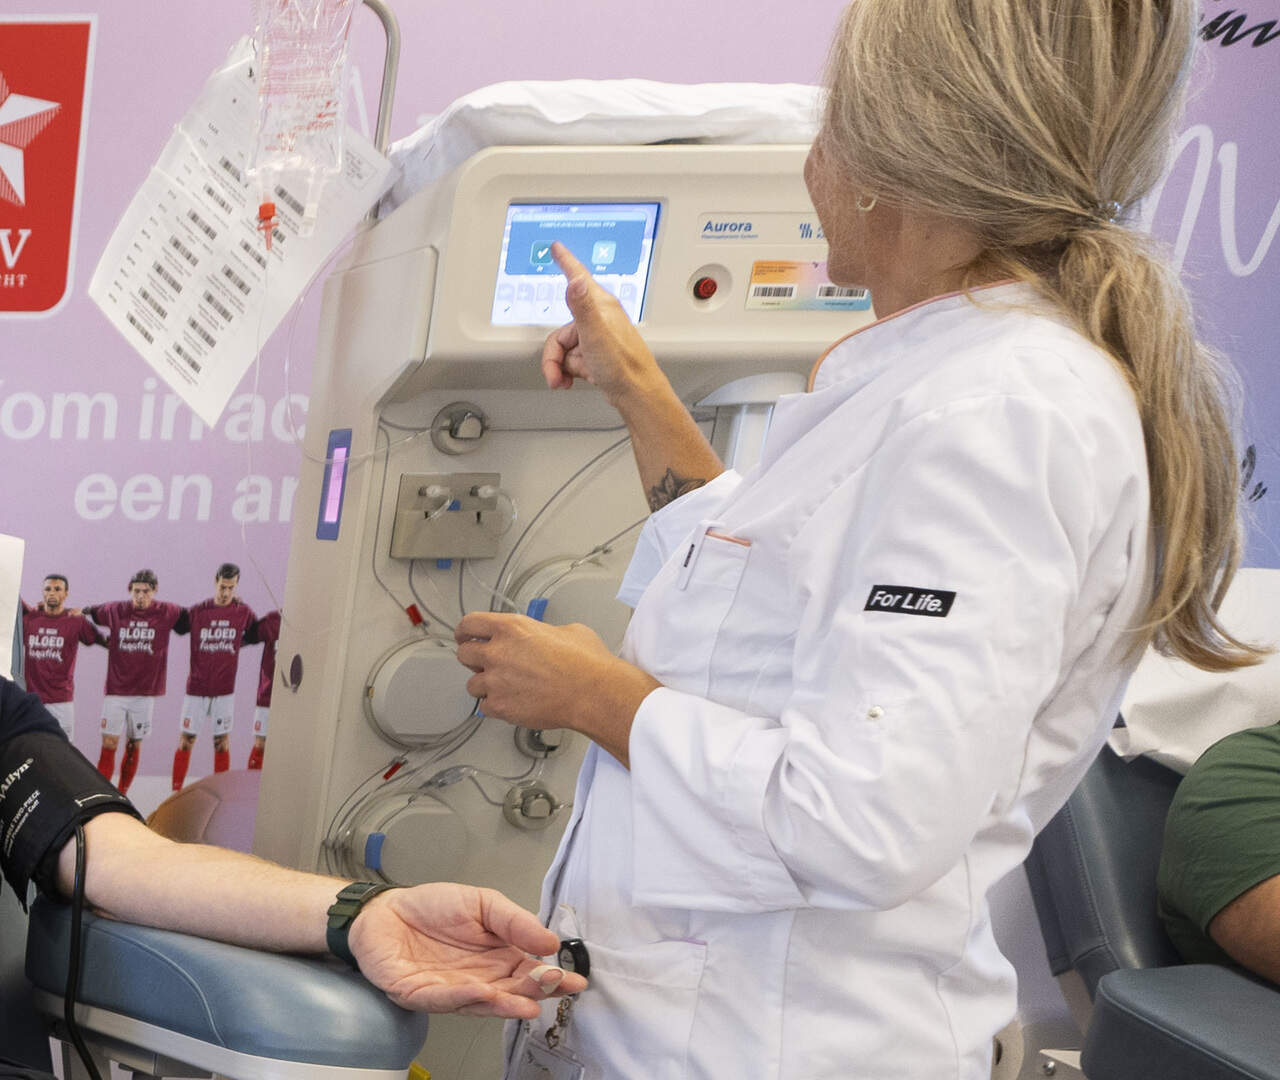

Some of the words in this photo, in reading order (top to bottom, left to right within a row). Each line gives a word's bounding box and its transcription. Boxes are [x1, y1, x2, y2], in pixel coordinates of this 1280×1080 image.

[703, 220, 753, 232] Aurora
[138, 377, 204, 441] in
[74, 472, 213, 522] een
[869, 590, 903, 608] For
[901, 592, 944, 613] Life.
[119, 627, 156, 640] BLOED
[200, 627, 237, 640] BLOED
[29, 634, 65, 648] BLOED
